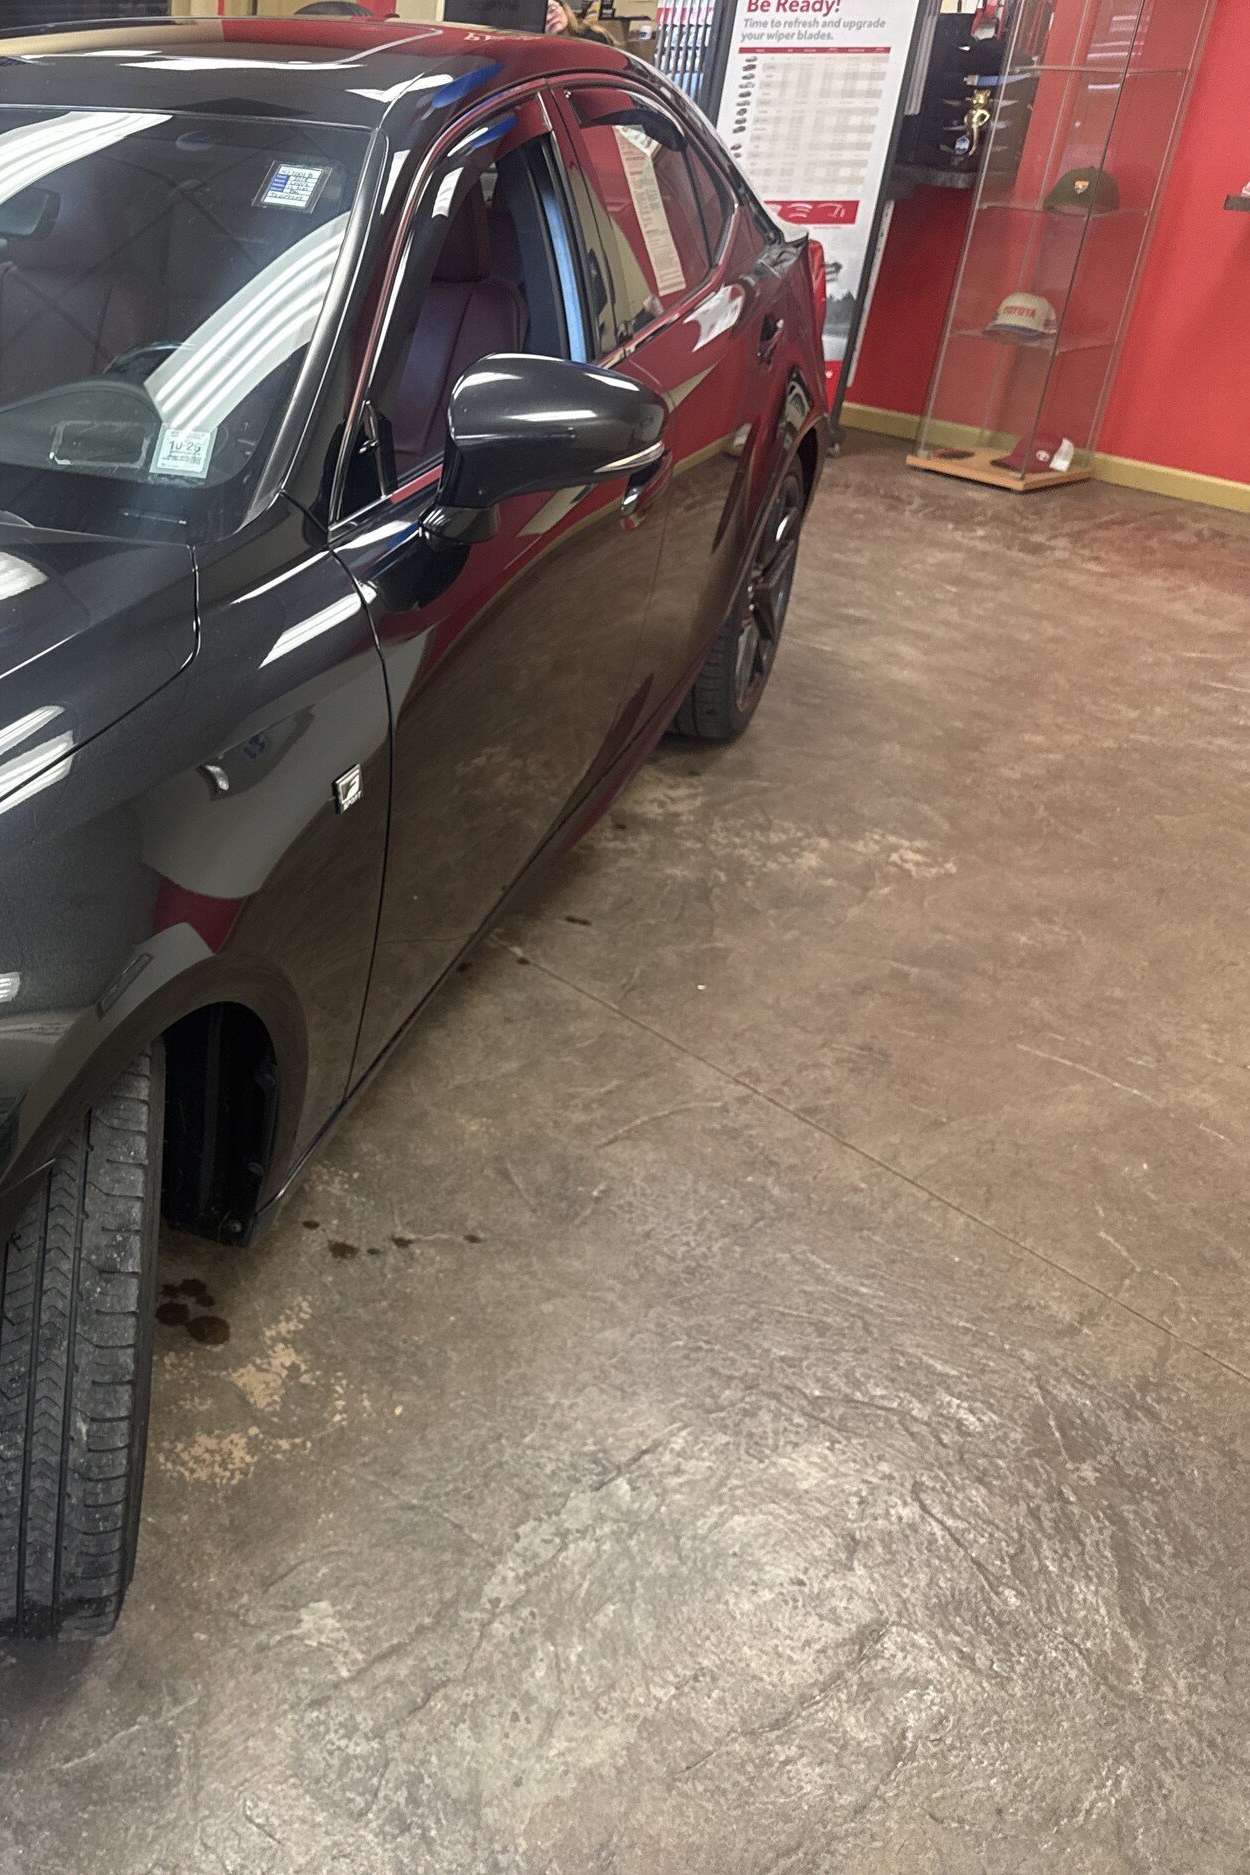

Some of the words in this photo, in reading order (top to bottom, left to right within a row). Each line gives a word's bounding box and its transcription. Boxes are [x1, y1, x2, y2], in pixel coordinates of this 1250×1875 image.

[746, 0, 771, 13] Be
[775, 0, 842, 17] Ready!
[743, 18, 768, 28] Time
[770, 19, 781, 28] to
[783, 18, 819, 28] refresh
[821, 18, 841, 28] and
[843, 18, 886, 31] upgrade
[741, 32, 764, 42] your
[766, 30, 795, 42] wiper
[797, 30, 834, 41] blades.
